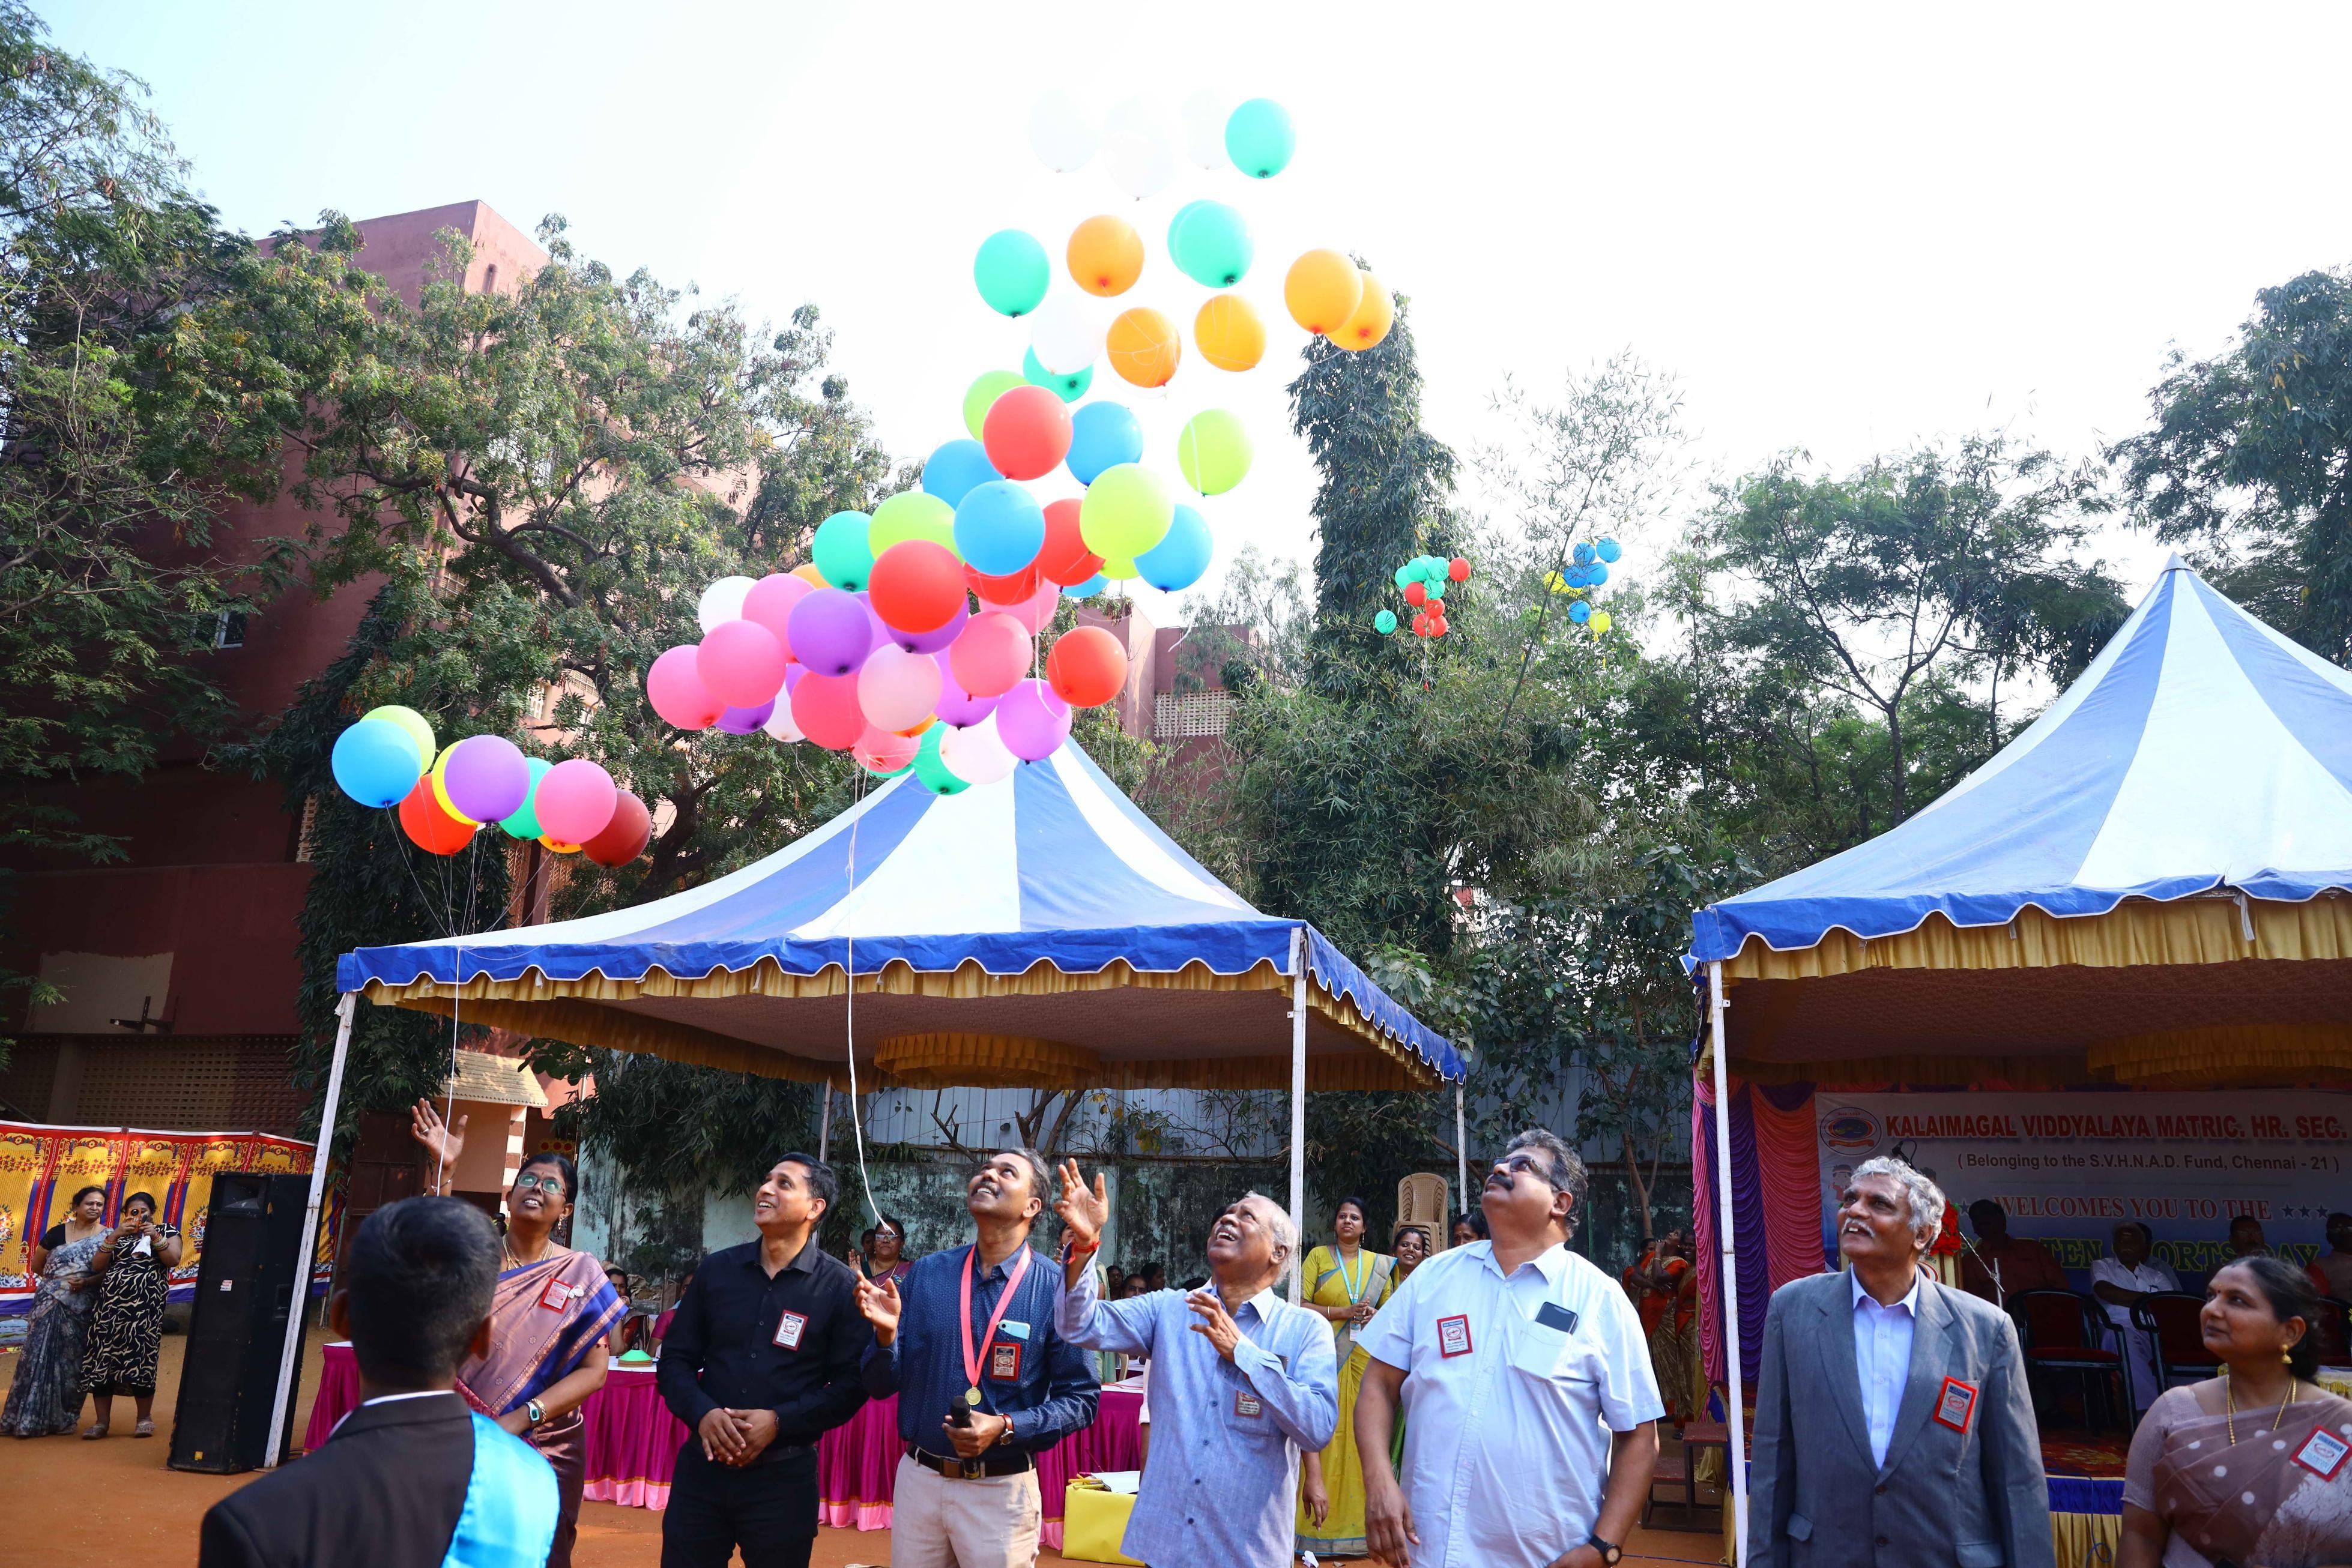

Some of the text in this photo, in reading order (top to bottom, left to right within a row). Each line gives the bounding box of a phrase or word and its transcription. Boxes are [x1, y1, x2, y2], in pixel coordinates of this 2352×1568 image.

[1885, 1115, 2348, 1139] KALAIMAGAL VIDDYALAYA MATRIC. HR. SEC.
[1967, 1154, 2040, 1170] Belonging
[2043, 1154, 2058, 1167] to
[2062, 1154, 2085, 1167] the
[2090, 1154, 2180, 1168] S.V.H.N.A.D.
[2184, 1155, 2228, 1171] Fund,
[2232, 1156, 2297, 1170] Chennai
[2311, 1156, 2328, 1170] 21
[1994, 1196, 2272, 1220] WELCOMES YOU TO THE
